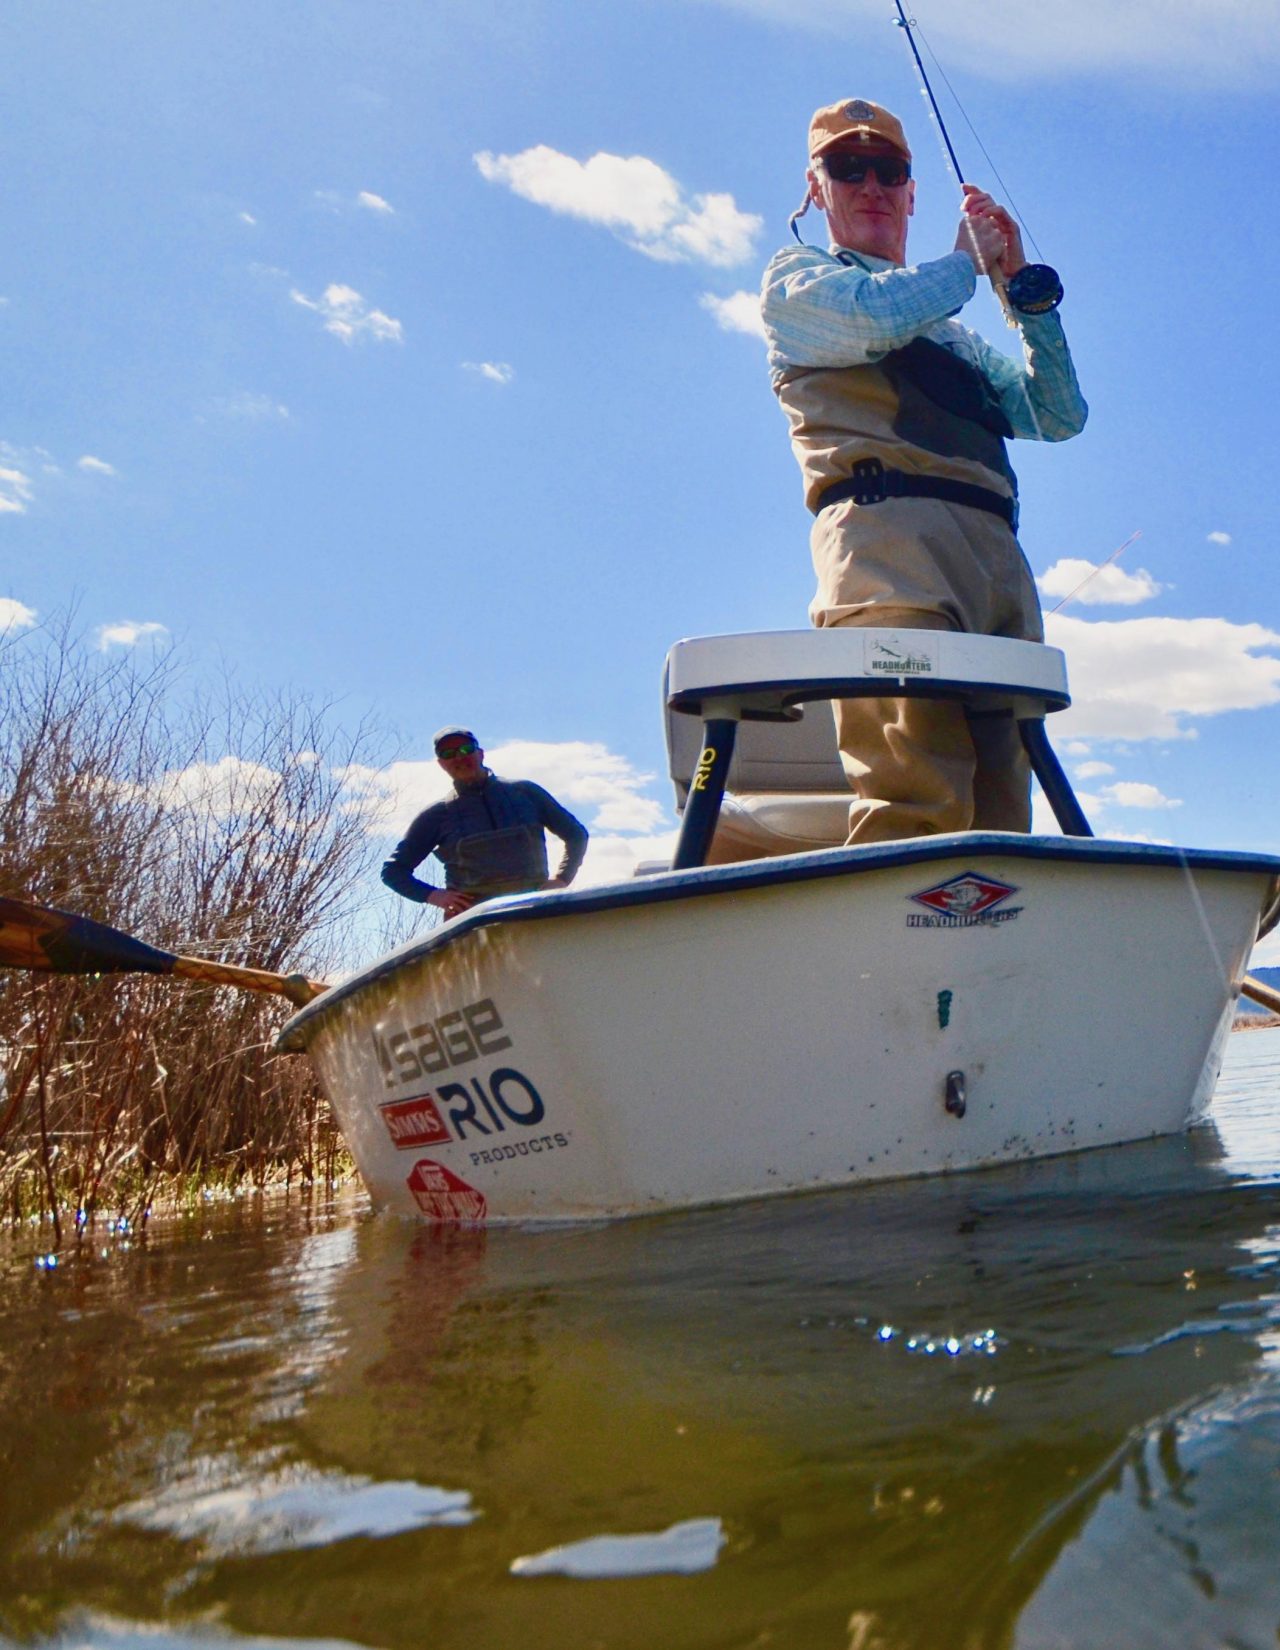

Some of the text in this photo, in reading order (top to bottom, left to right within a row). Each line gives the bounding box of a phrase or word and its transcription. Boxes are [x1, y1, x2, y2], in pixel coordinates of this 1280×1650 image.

[692, 747, 717, 790] RIO
[436, 1067, 545, 1141] RIO
[385, 1110, 441, 1139] SIMMS
[470, 1132, 569, 1166] PRODUCTS
